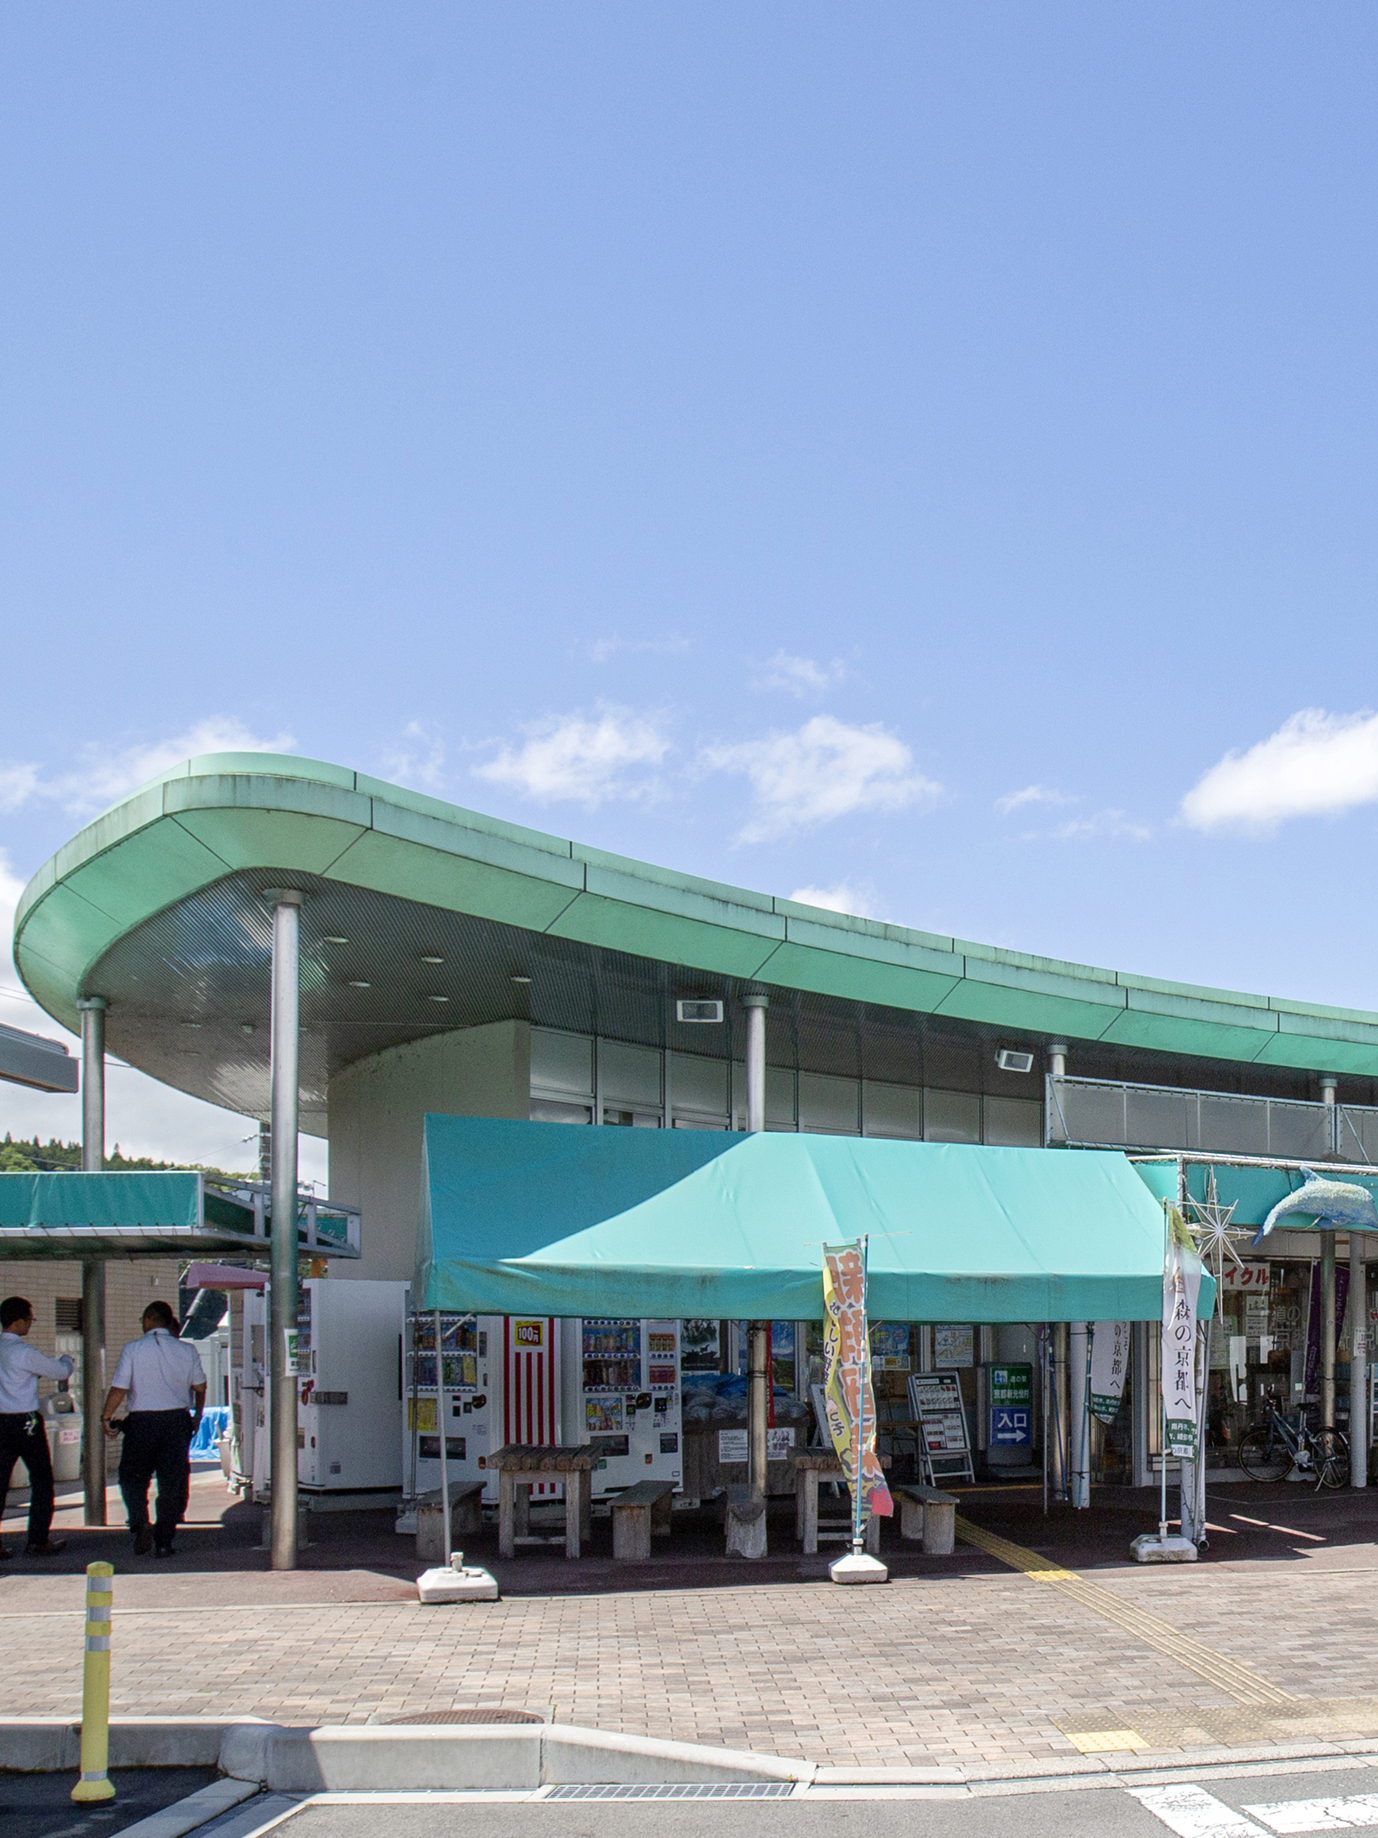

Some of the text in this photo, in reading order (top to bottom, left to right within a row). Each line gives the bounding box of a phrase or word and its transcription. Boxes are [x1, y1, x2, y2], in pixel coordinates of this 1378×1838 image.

[1211, 1265, 1269, 1286] イクル
[1174, 1299, 1192, 1410] 森の京都へ
[998, 1413, 1026, 1428] 入口
